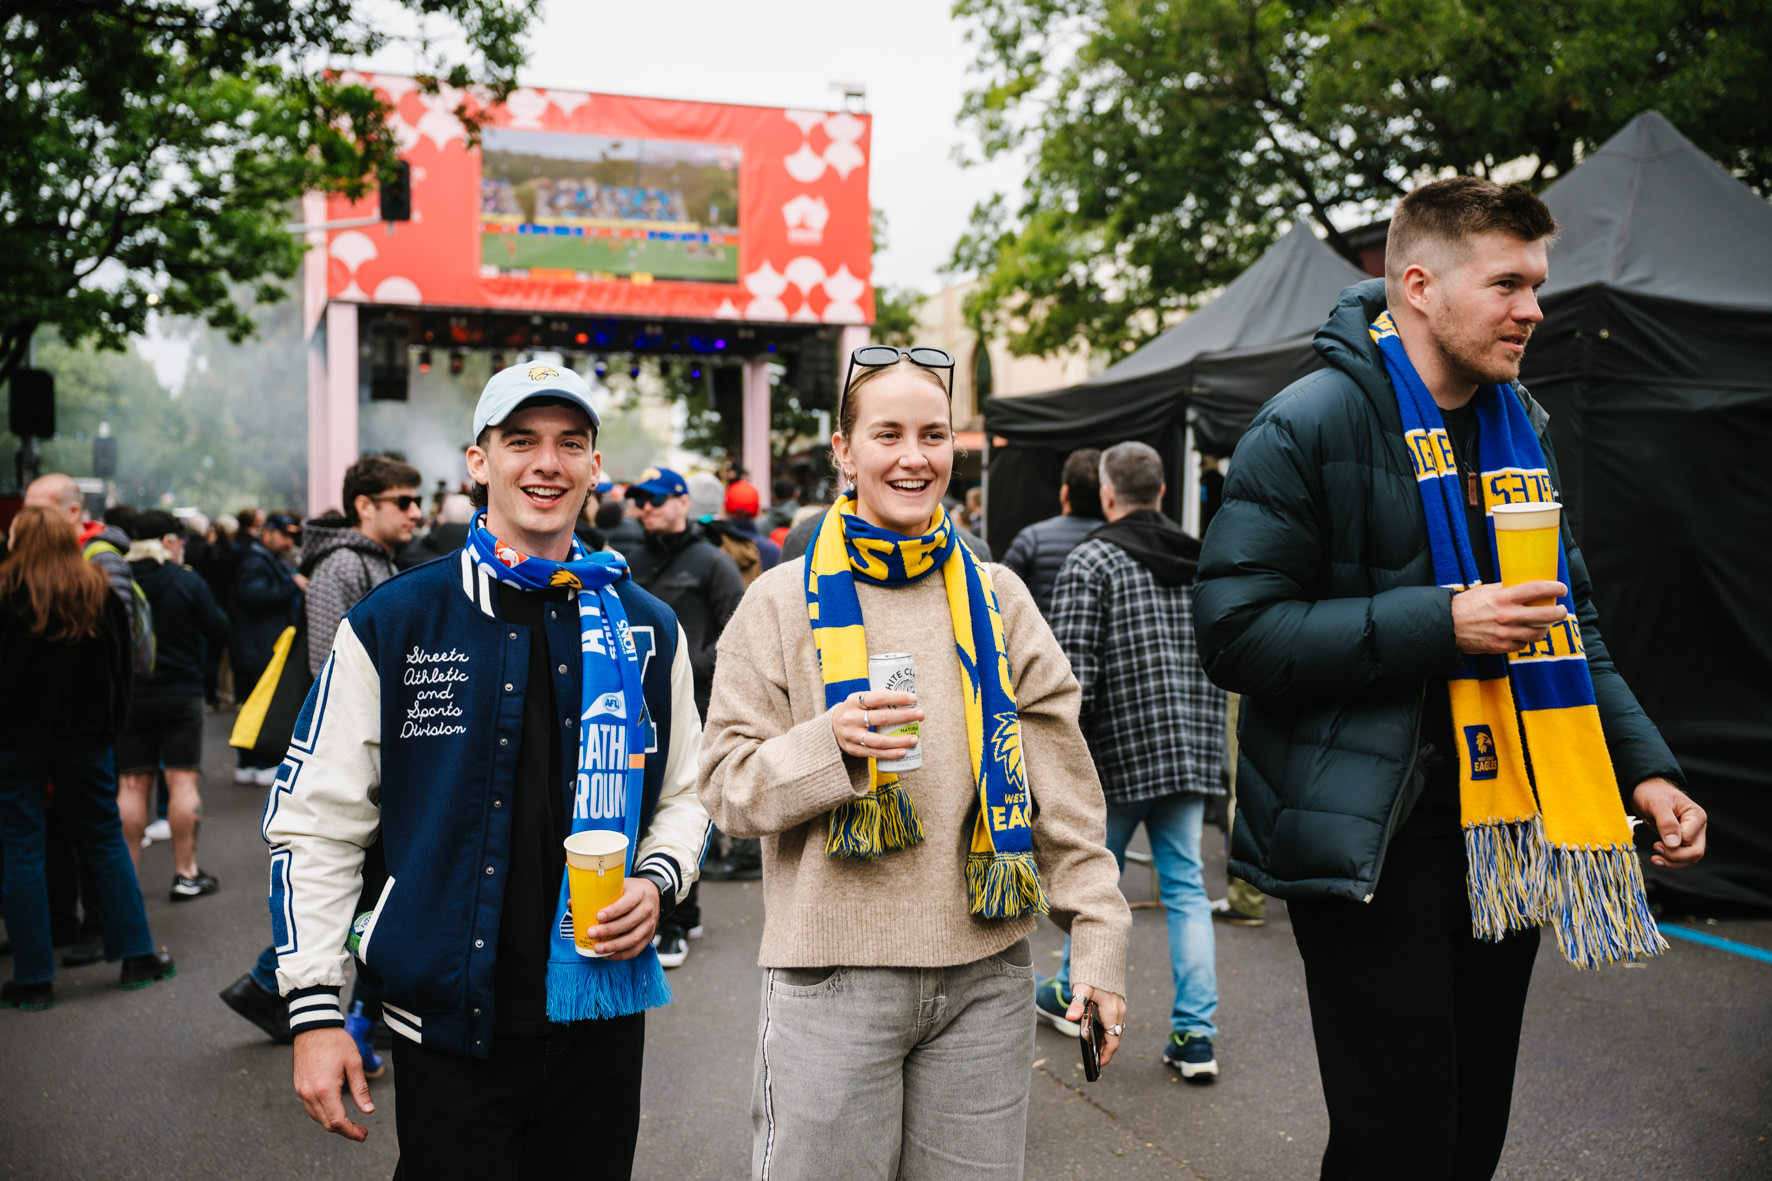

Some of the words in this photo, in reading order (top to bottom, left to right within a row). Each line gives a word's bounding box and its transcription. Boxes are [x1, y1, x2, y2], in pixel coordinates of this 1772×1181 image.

[616, 620, 638, 662] LIONS
[403, 666, 469, 686] Athletic
[885, 670, 903, 690] HITE
[417, 682, 454, 700] and
[406, 700, 463, 723] Sports
[604, 698, 621, 710] AFL
[400, 720, 467, 739] Division
[1474, 760, 1497, 772] EAGLES
